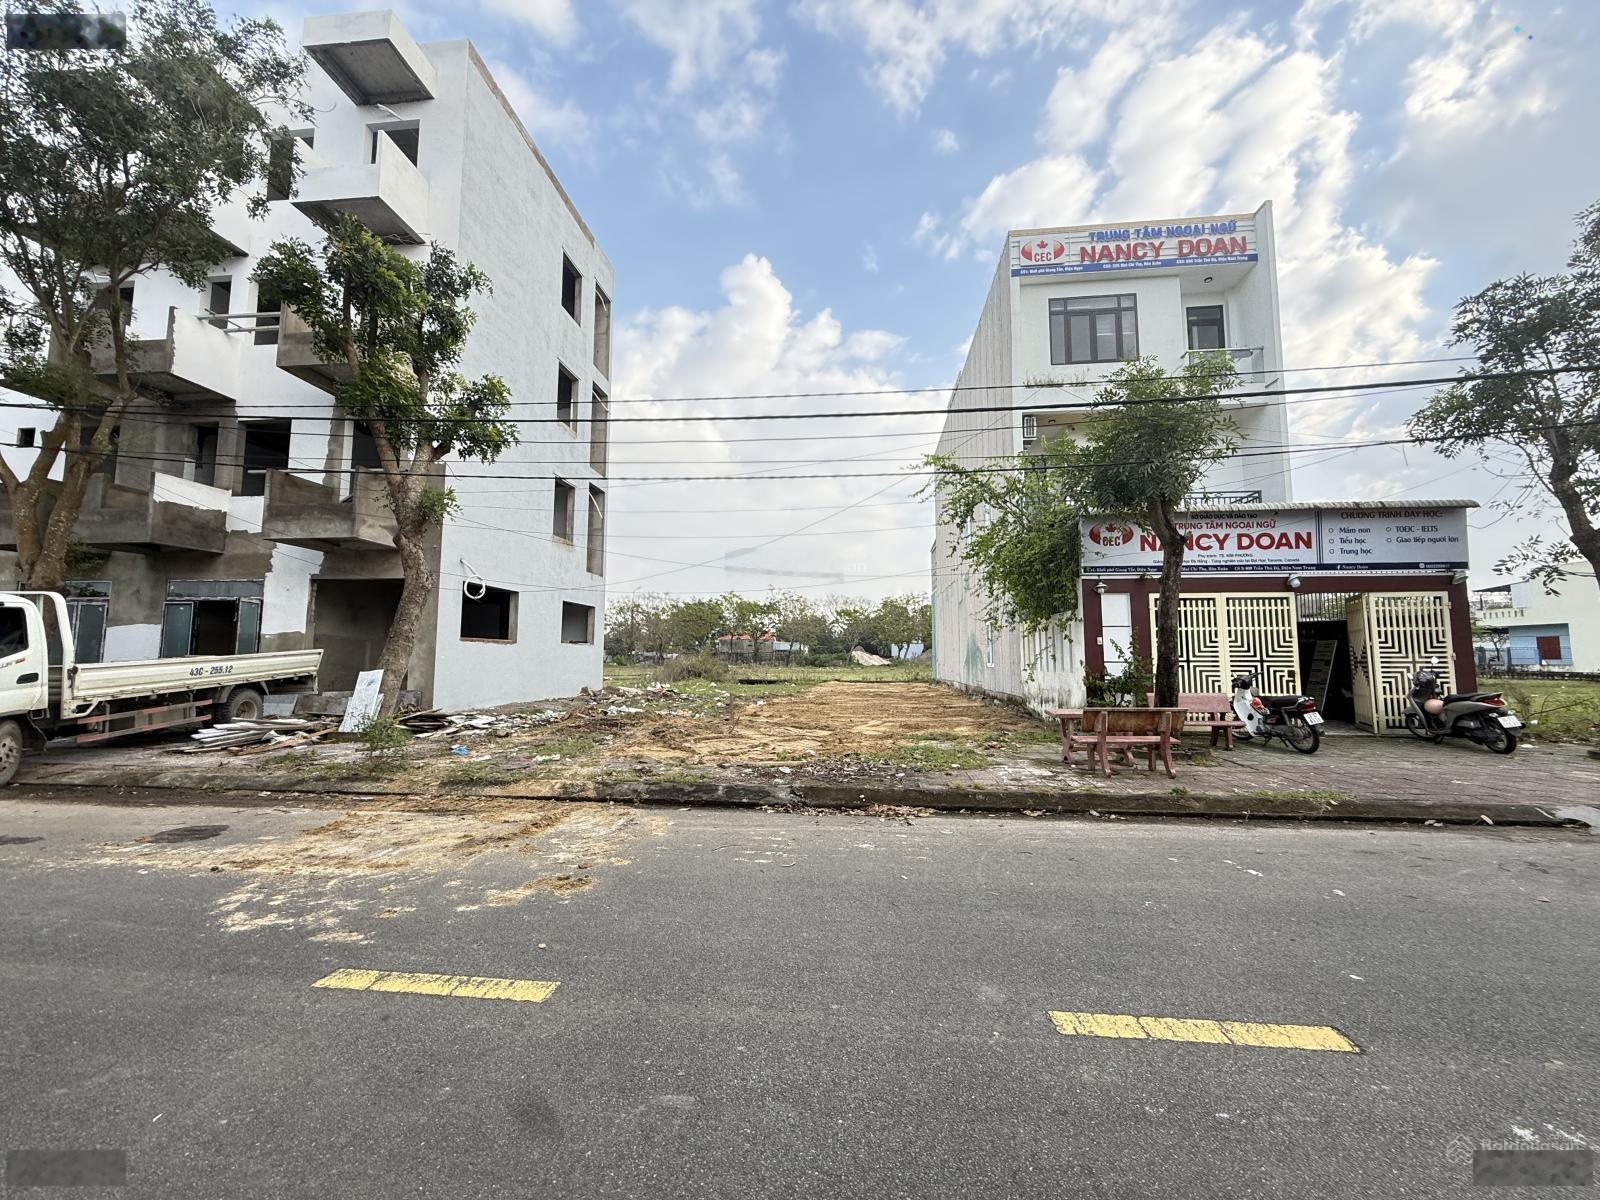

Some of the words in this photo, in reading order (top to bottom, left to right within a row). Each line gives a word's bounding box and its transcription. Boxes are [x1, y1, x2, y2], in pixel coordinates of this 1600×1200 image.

[1088, 229, 1131, 241] TRUNG
[1134, 224, 1162, 240] TÂM
[1080, 241, 1166, 263] NANCY
[1177, 236, 1249, 257] DOAN
[1034, 252, 1052, 262] CEC
[1205, 520, 1224, 530] TÂM
[1226, 520, 1254, 531] NGOẠI
[1256, 518, 1276, 528] NGỮ
[1102, 536, 1121, 547] CEC
[1140, 533, 1231, 551] NNCY
[1236, 532, 1312, 551] DOAN
[1354, 537, 1367, 546] học
[190, 667, 204, 676] 43C
[210, 665, 233, 675] 255.12
